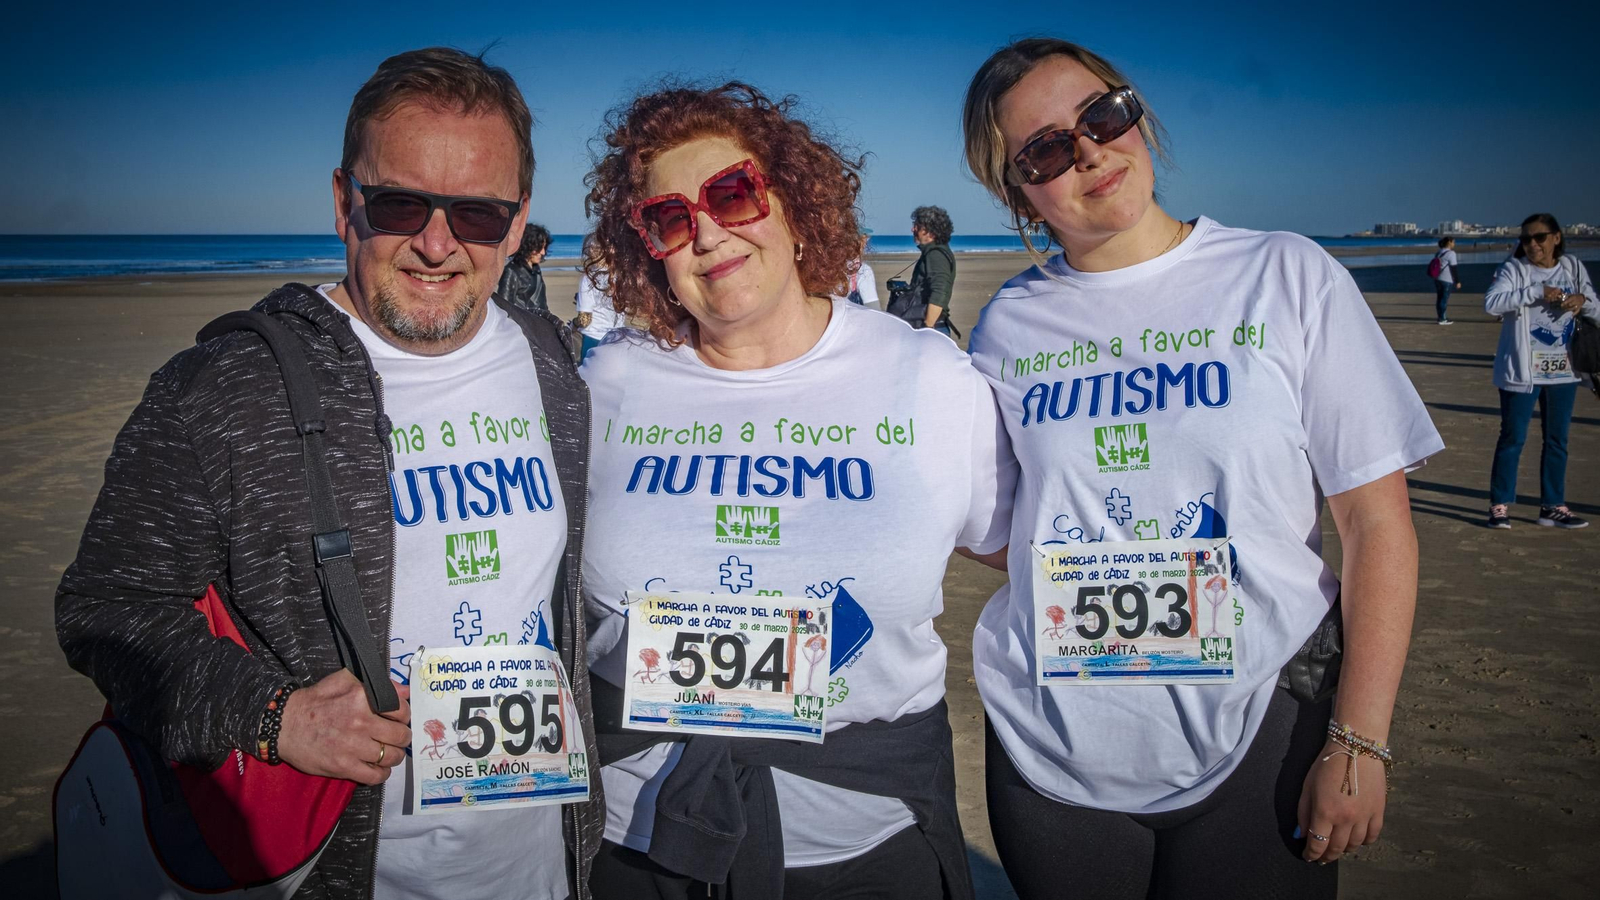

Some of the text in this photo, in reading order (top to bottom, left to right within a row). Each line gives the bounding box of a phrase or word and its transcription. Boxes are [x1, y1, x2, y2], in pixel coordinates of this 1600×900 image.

[1014, 340, 1098, 378] marcha
[1109, 336, 1123, 358] a
[1139, 328, 1215, 353] favor
[1233, 319, 1265, 350] del
[1541, 359, 1566, 371] 356
[1021, 361, 1231, 428] AUTISMO
[440, 420, 456, 447] a
[469, 411, 530, 444] favor
[622, 421, 723, 445] marcha
[740, 422, 755, 443] a
[774, 418, 857, 446] favor
[876, 416, 915, 446] del
[1098, 463, 1150, 473] AUTISMO CÁDIZ
[626, 455, 875, 501] AUTISMO
[389, 456, 554, 527] UTISMO
[715, 537, 781, 546] AUTISMO CÁDIZ
[1051, 557, 1054, 566] I
[1059, 555, 1097, 566] MARCHA
[1101, 554, 1109, 564] A
[1113, 553, 1144, 564] FAVOR
[1149, 552, 1166, 562] DEL
[448, 573, 500, 587] AUTISMO CÁDIZ
[1088, 570, 1099, 580] de
[1138, 571, 1146, 579] 30
[1150, 570, 1159, 578] de
[1190, 569, 1206, 577] 2025
[649, 600, 652, 609] I
[657, 601, 698, 611] MARCHA
[703, 604, 710, 612] A
[715, 605, 747, 616] FAVOR
[752, 607, 769, 617] DEL
[1075, 583, 1192, 640] 593
[688, 616, 700, 627] de
[751, 623, 760, 631] de
[791, 626, 808, 634] 2025
[1059, 644, 1138, 656] MARGARITA
[429, 663, 432, 674] I
[437, 661, 482, 674] MARCHA
[487, 660, 495, 672] A
[500, 659, 532, 671] FAVOR
[535, 659, 546, 671] DEL
[669, 632, 790, 693] 594
[472, 678, 485, 690] de
[526, 679, 533, 688] 30
[536, 679, 543, 688] de
[674, 692, 715, 705] JUANI
[457, 693, 564, 759] 595
[436, 762, 474, 779] JOSÉ
[478, 759, 530, 777] RAMÓN
